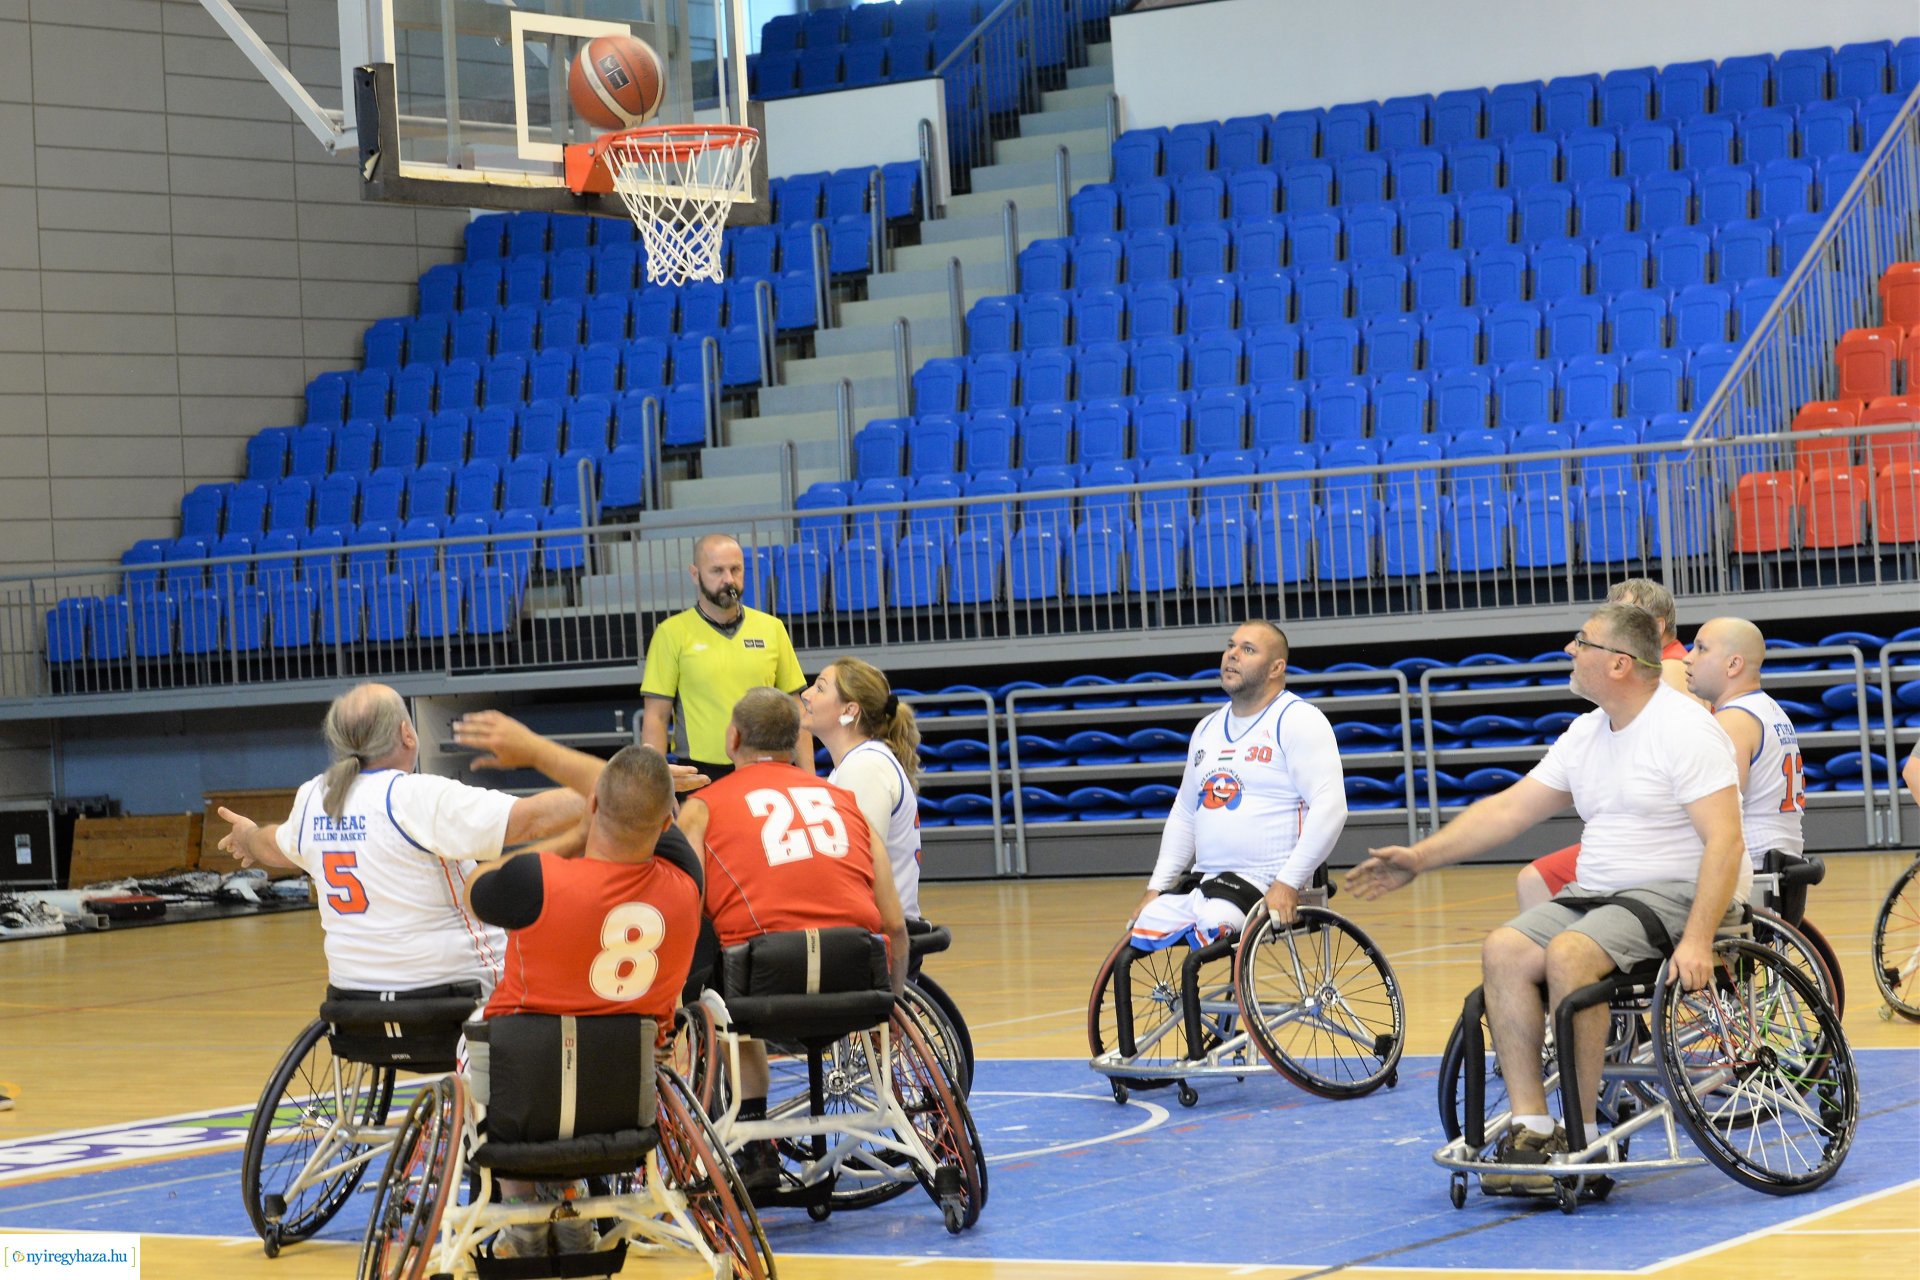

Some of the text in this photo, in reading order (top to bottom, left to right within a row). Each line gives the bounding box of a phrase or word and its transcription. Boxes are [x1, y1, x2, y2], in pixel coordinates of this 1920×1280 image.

[1244, 745, 1273, 763] 30
[313, 816, 333, 831] PTE
[744, 786, 849, 867] 25
[322, 851, 370, 914] 5
[589, 901, 666, 1002] 8
